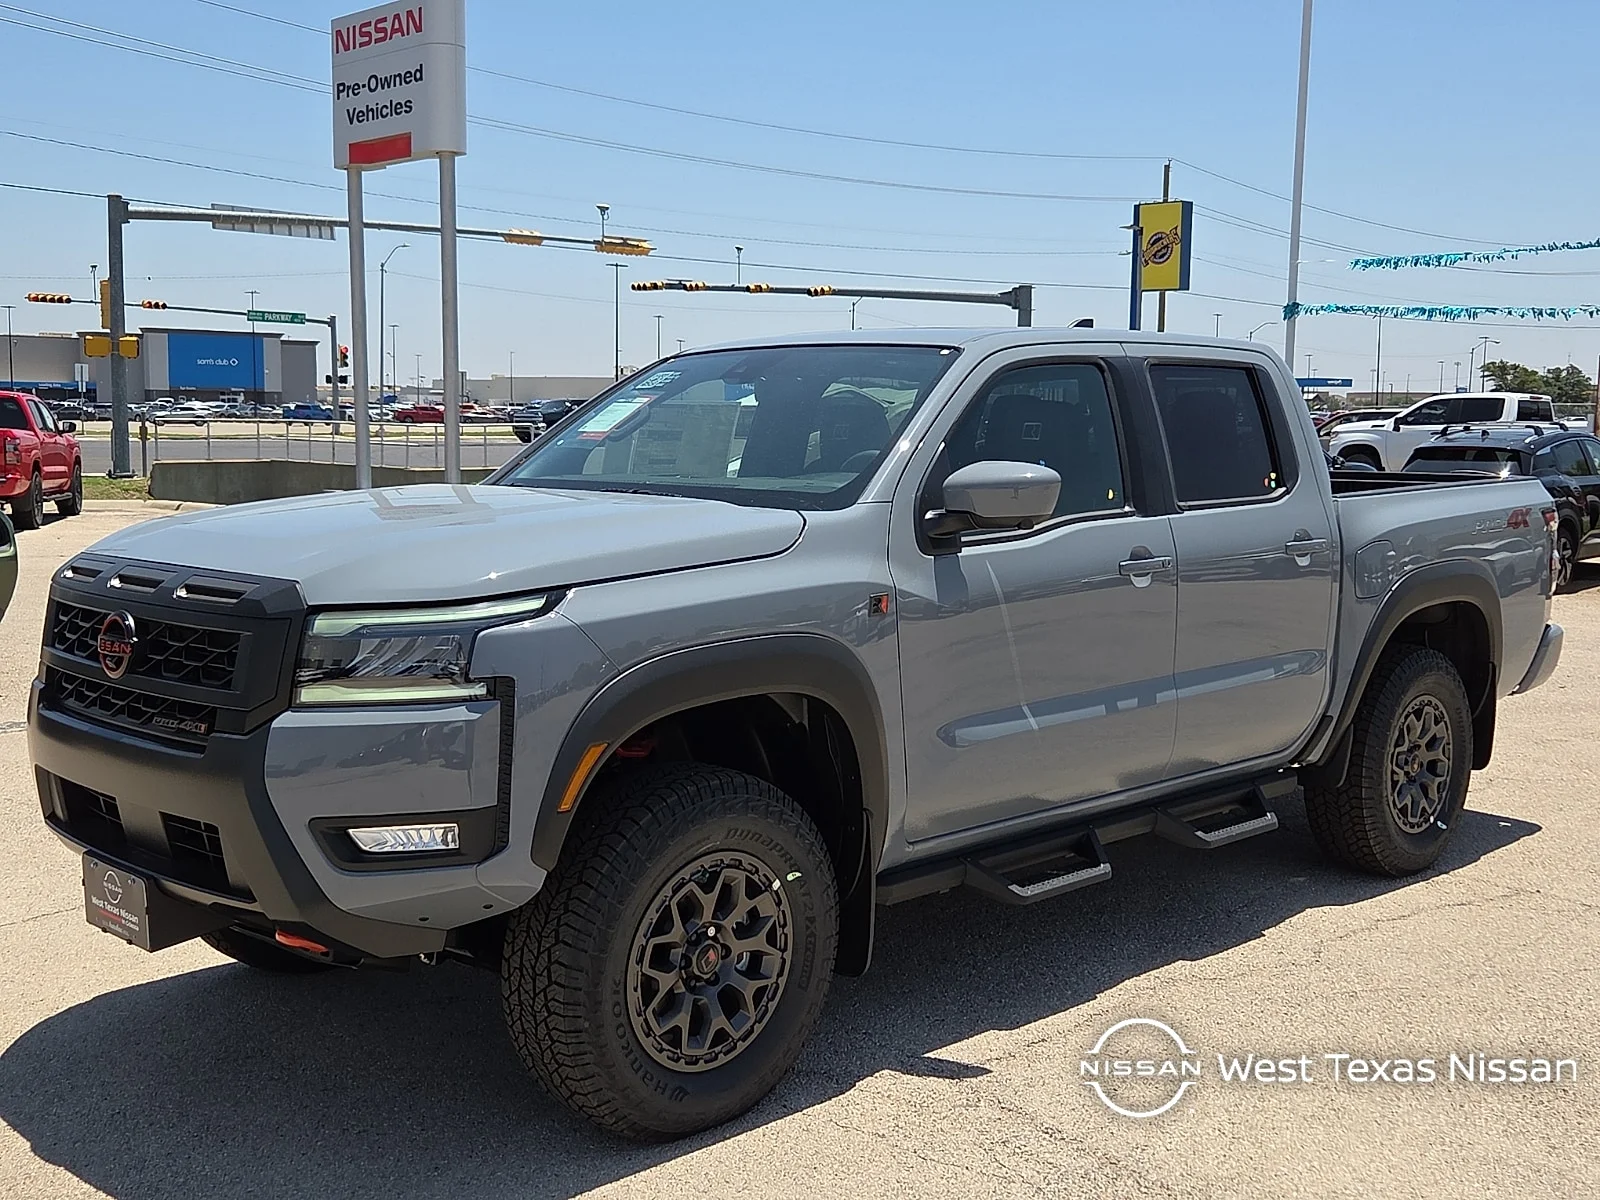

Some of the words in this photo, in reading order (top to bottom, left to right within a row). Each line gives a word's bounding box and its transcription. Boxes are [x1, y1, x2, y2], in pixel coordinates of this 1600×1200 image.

[335, 6, 423, 54] NISSAN
[336, 63, 424, 101] Pre-Owned
[346, 99, 413, 125] Vehicles
[264, 313, 293, 322] PARKWAY
[214, 358, 229, 366] club
